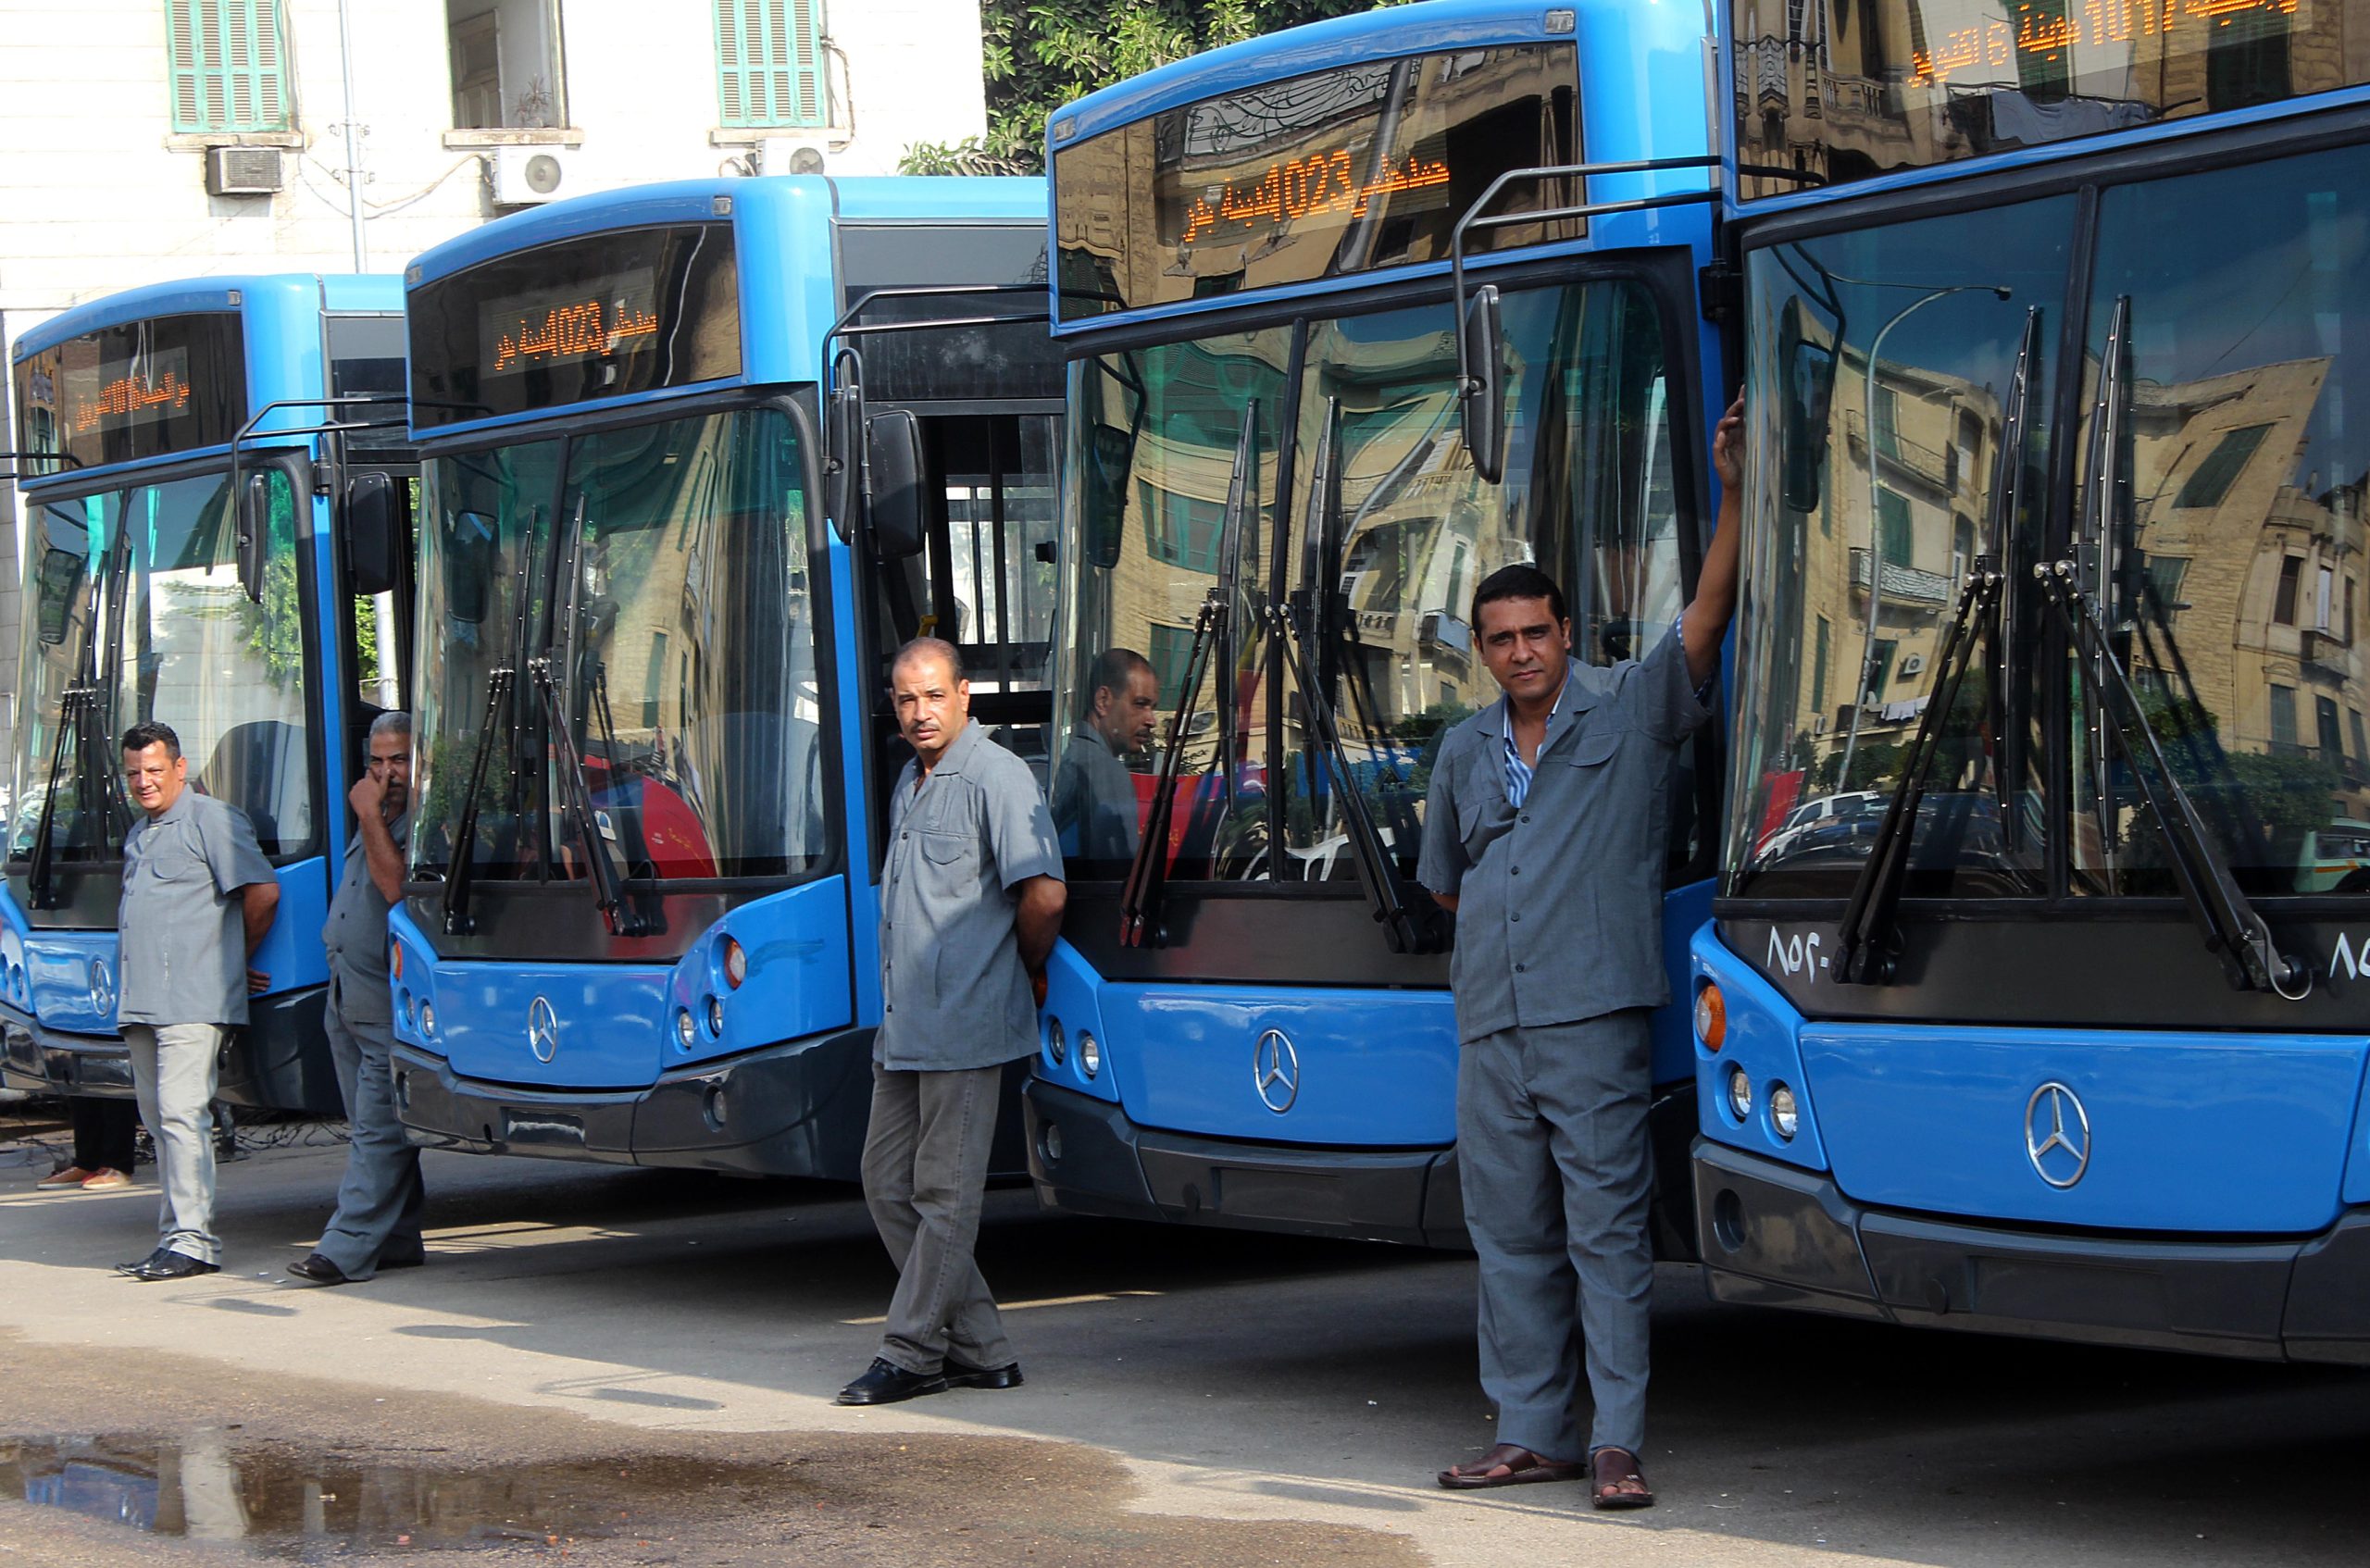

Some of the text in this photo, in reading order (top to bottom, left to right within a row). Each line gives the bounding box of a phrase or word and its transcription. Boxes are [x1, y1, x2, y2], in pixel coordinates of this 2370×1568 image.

[1986, 22, 2007, 66] 6
[2018, 3, 2080, 61] مدينة
[1265, 149, 1352, 222] 1023
[1182, 196, 1214, 243] بدر
